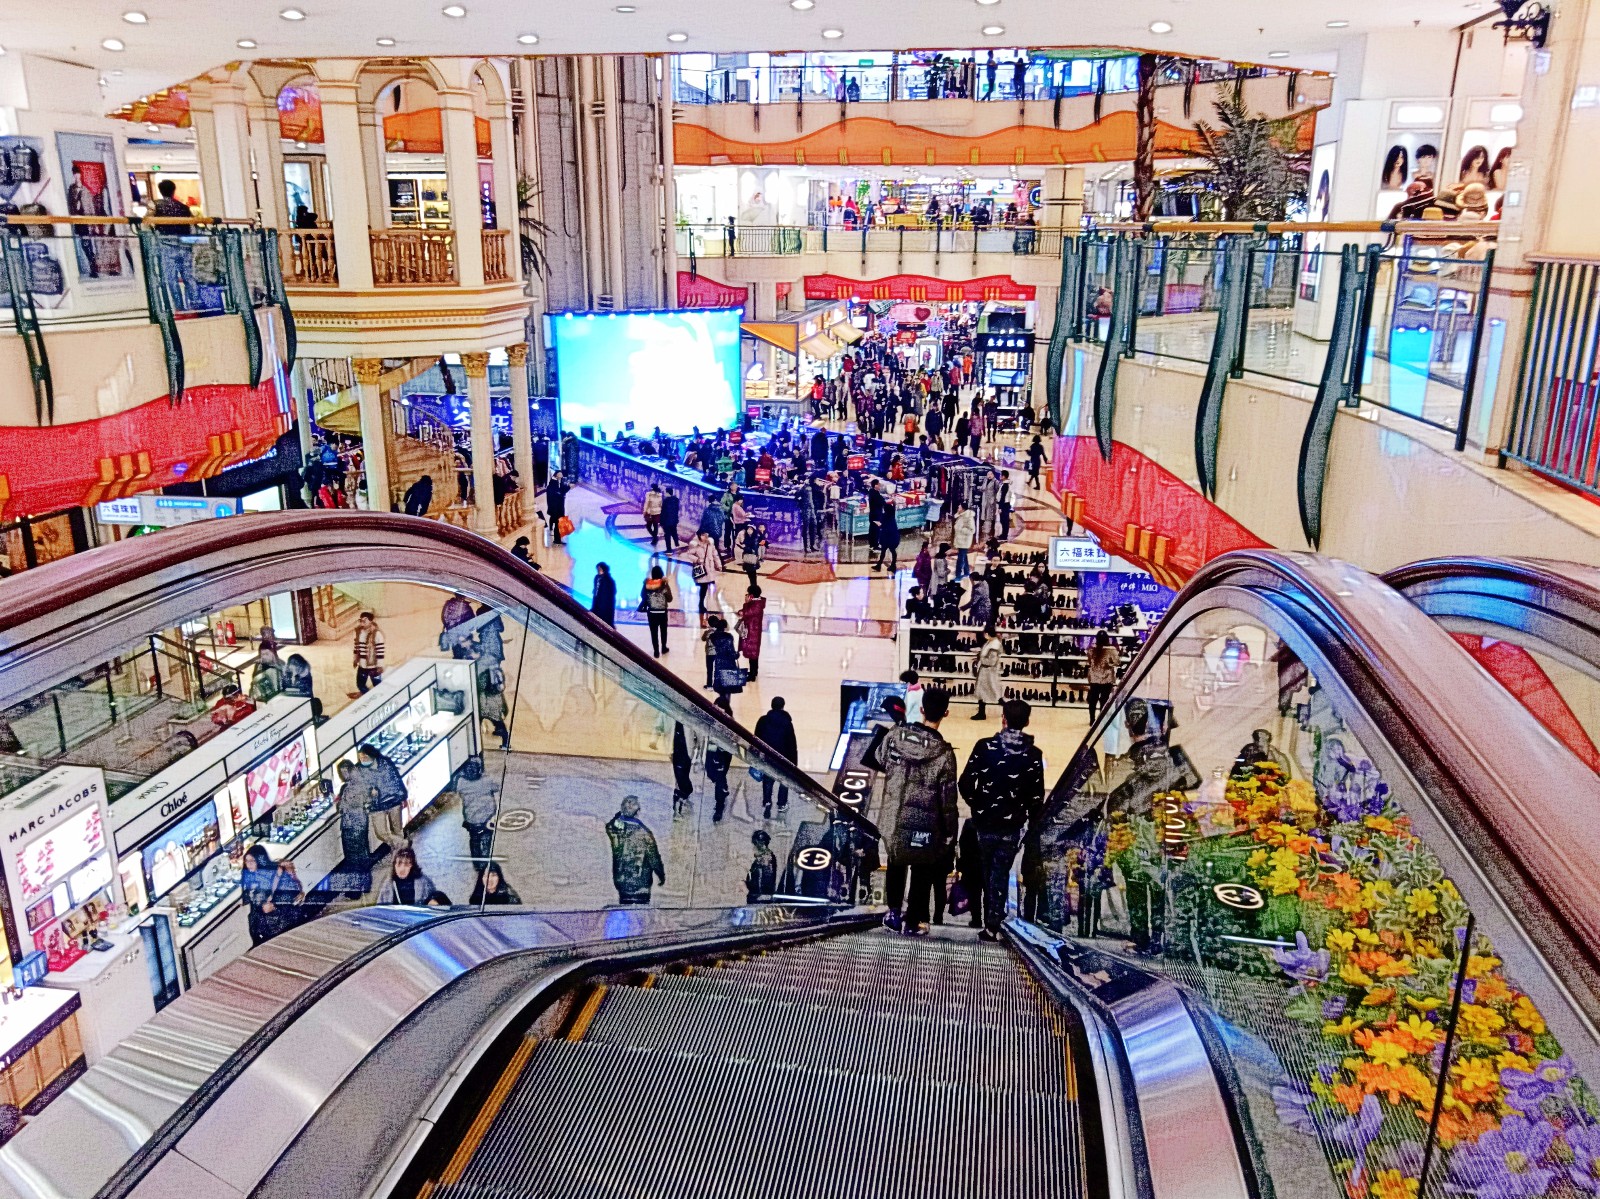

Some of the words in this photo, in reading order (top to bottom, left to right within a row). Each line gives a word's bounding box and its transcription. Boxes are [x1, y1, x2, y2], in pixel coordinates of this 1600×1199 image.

[103, 504, 138, 514] 六福珠寶
[160, 791, 188, 817] Chloé
[840, 771, 869, 813] CCI
[9, 815, 45, 842] MARC
[50, 783, 97, 818] JACOBS
